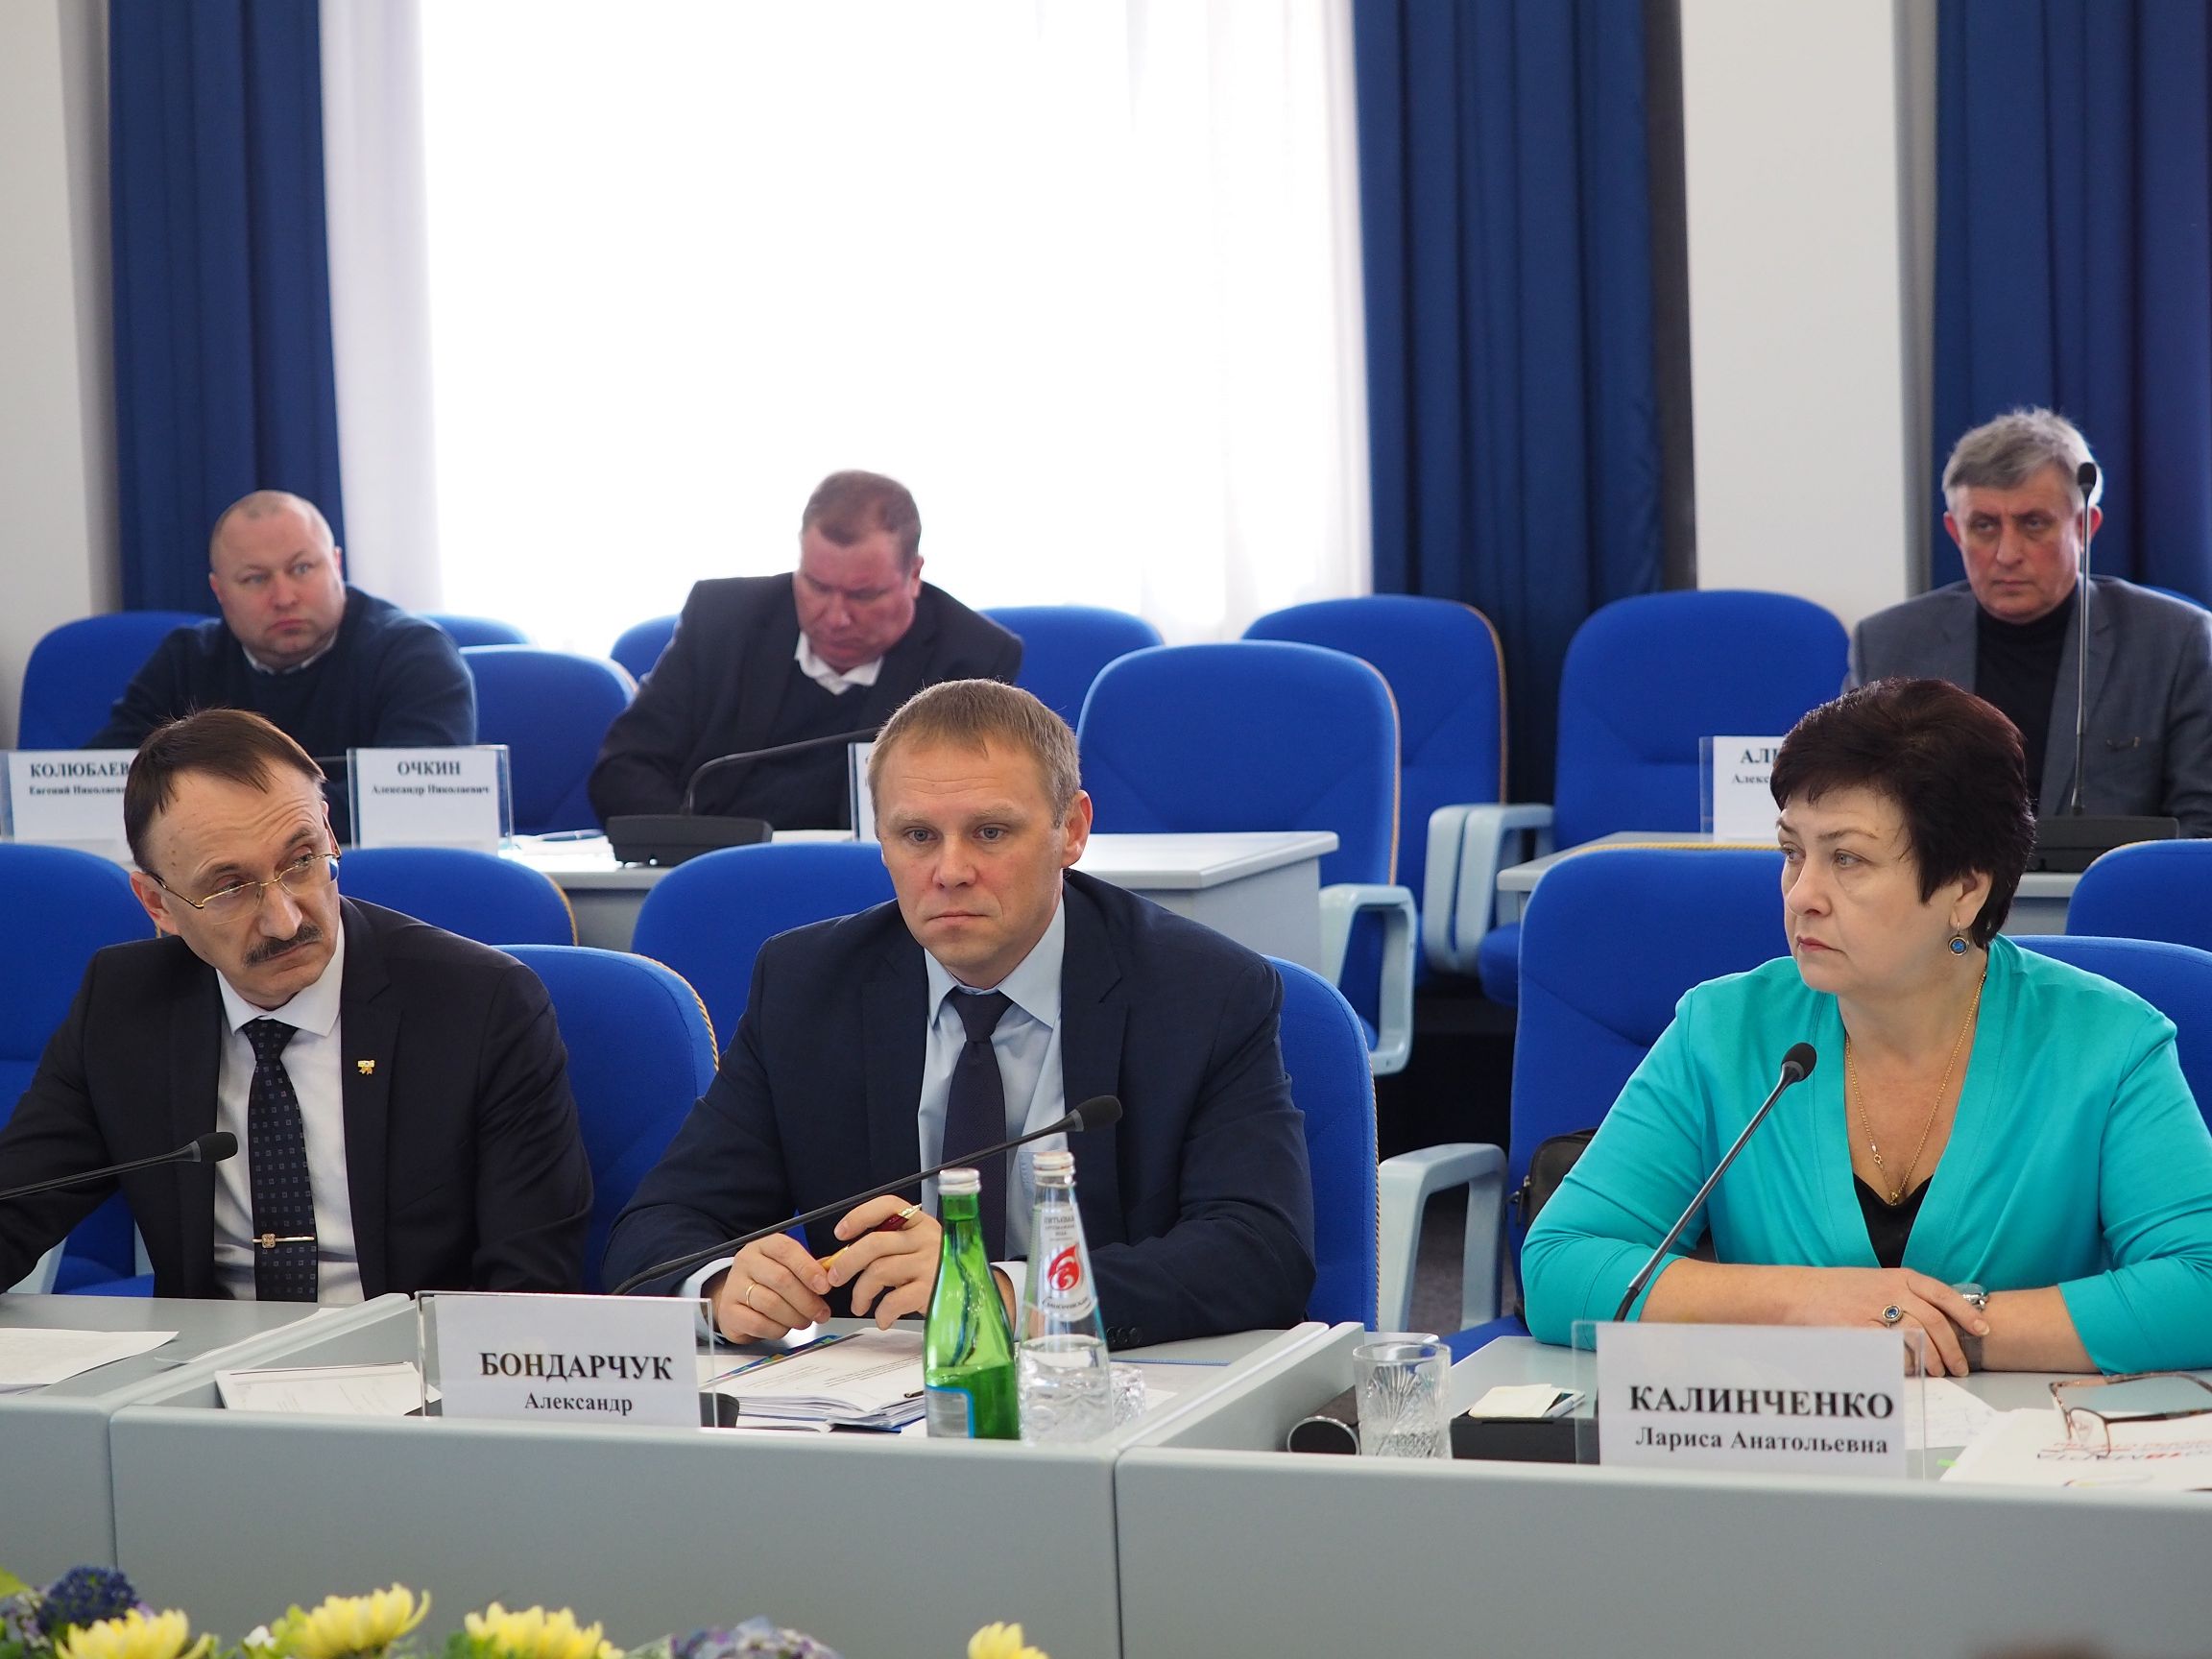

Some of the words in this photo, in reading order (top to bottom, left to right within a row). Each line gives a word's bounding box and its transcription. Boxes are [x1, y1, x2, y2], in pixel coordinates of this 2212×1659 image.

[397, 760, 462, 776] ОЧКИН
[1732, 774, 1770, 783] Алекс
[29, 785, 70, 796] Евгений
[371, 784, 424, 797] Александр
[427, 784, 490, 795] Николаевич
[478, 1352, 674, 1382] БОНДАРЧУК
[524, 1392, 634, 1416] Александр
[1628, 1384, 1894, 1420] КАЛИНЧЕНКО
[1635, 1427, 1723, 1452] Лариса
[1730, 1431, 1888, 1455] Анатольевна
